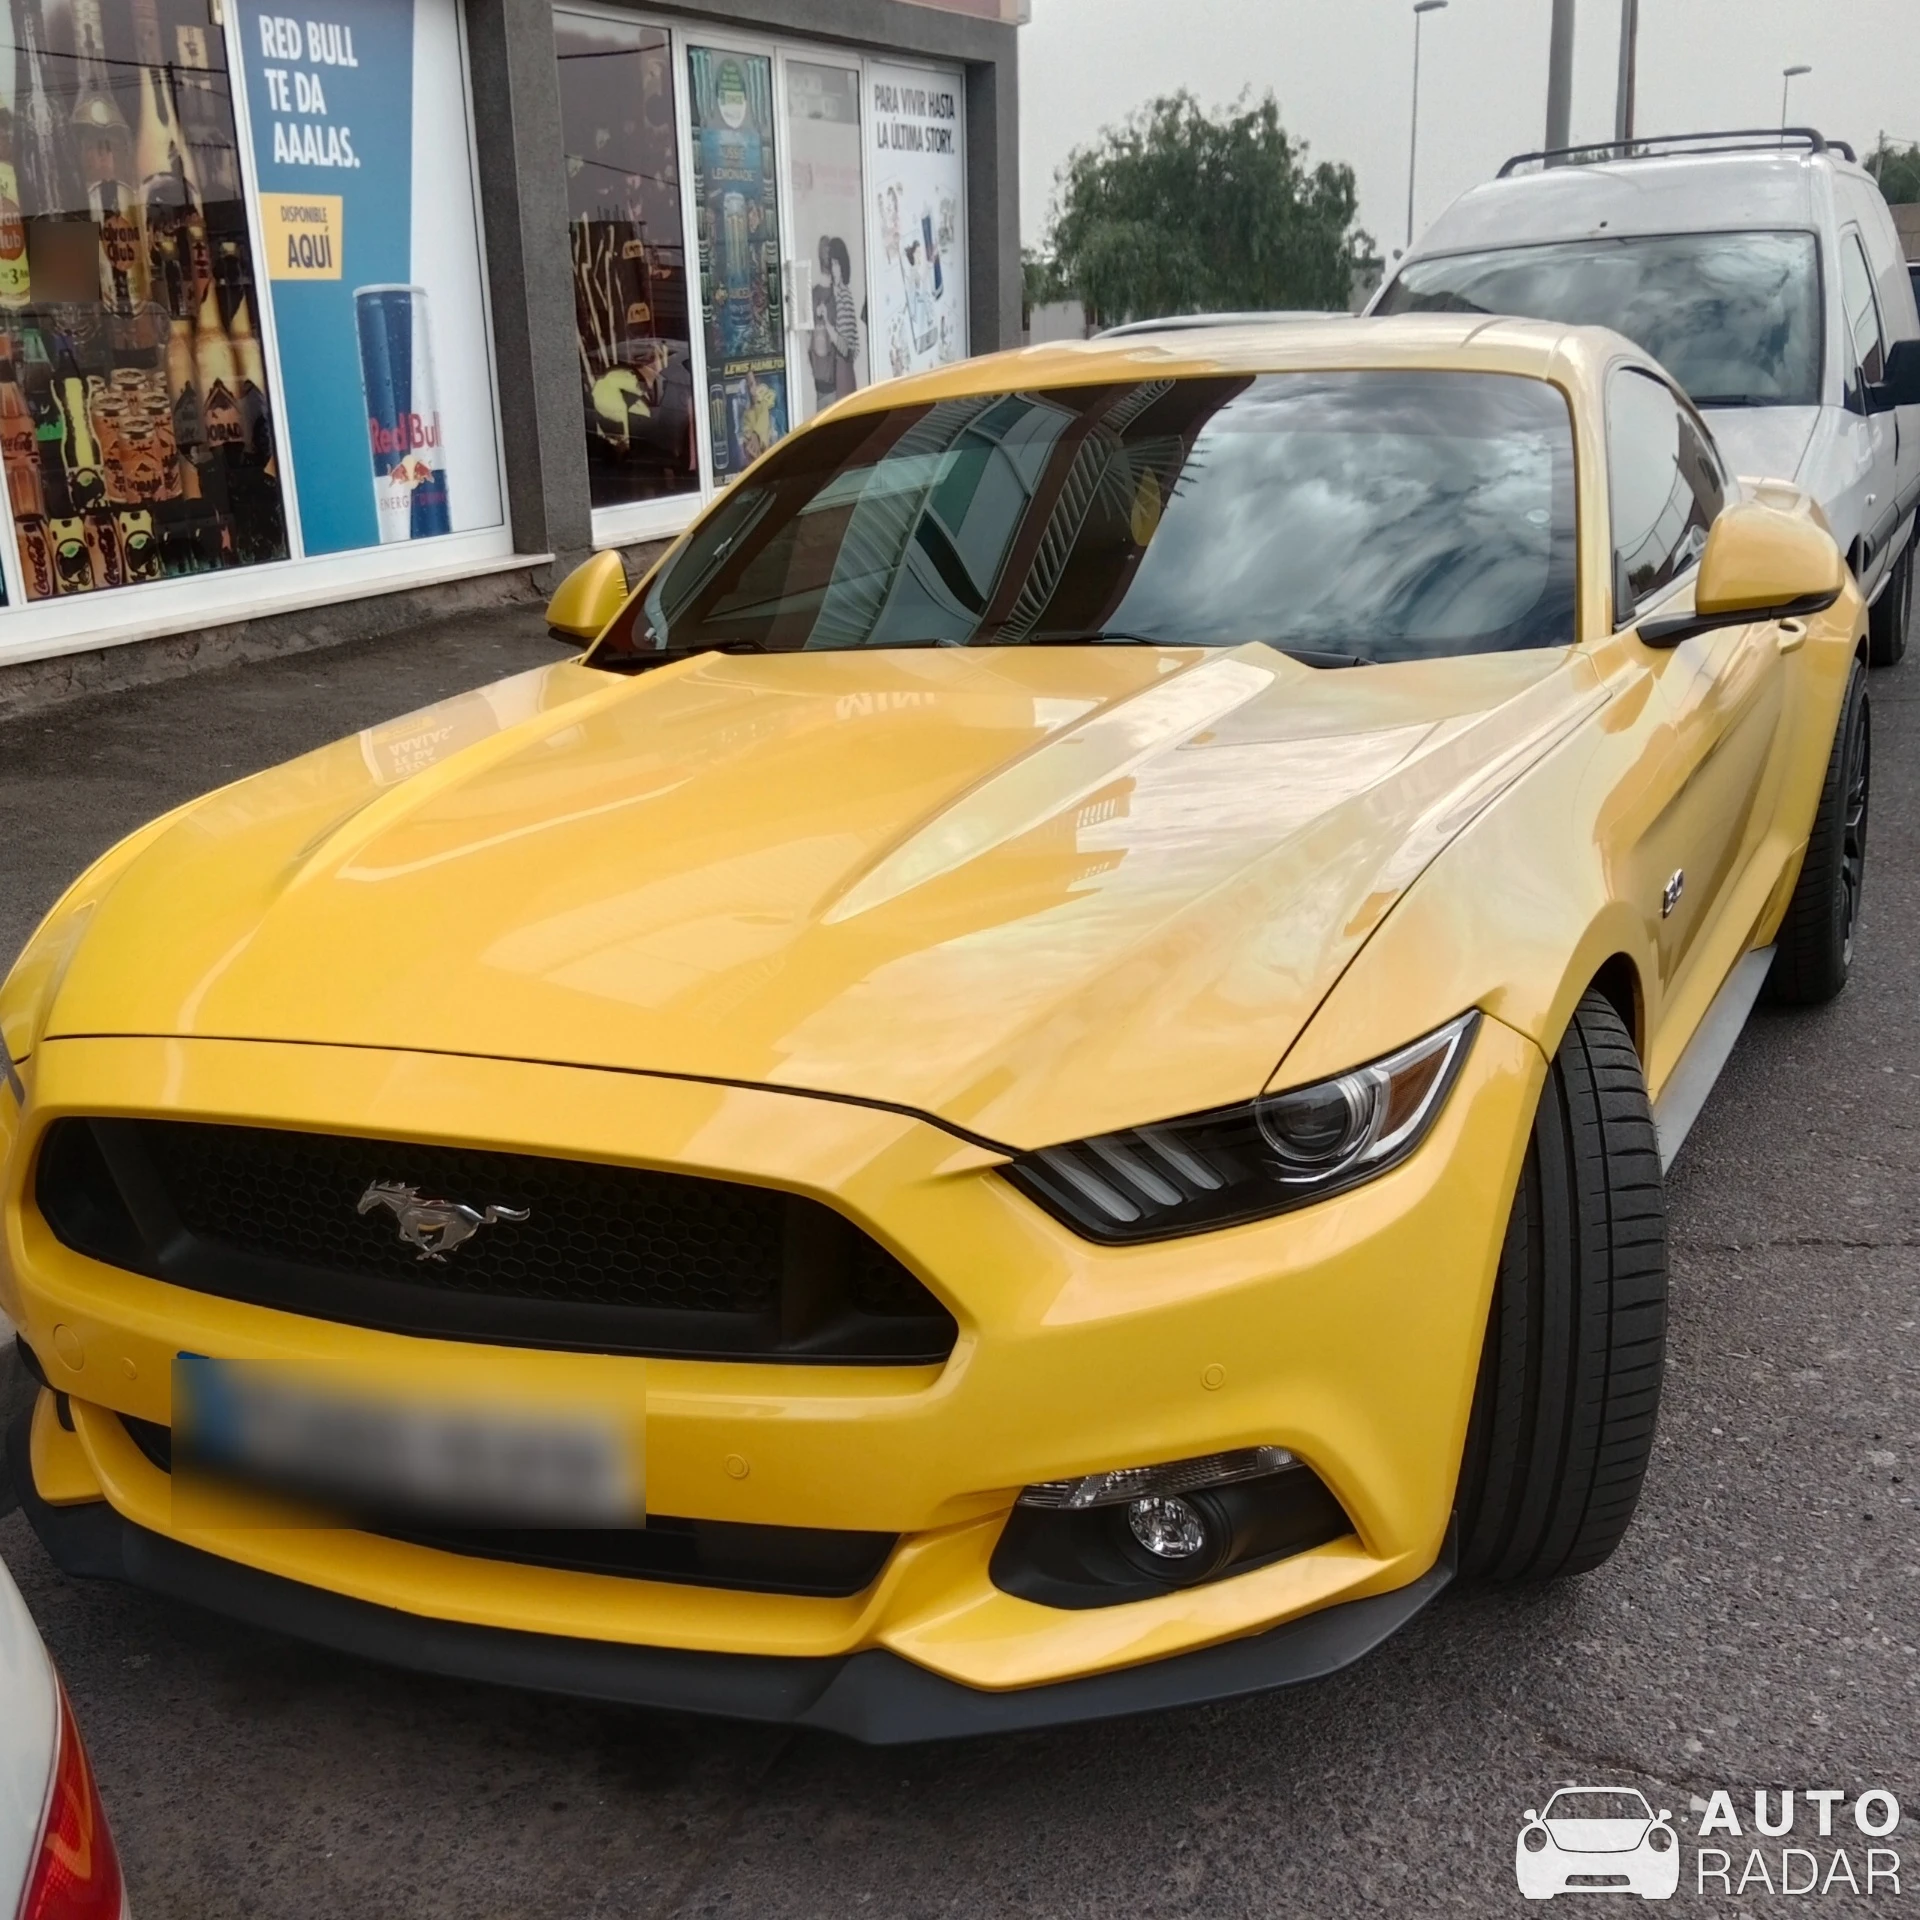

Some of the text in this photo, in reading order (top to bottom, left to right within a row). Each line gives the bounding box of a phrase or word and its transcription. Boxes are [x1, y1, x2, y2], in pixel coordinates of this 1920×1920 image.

[258, 14, 358, 67] RED BULL
[263, 68, 328, 115] TE DA
[874, 83, 900, 114] PARA
[900, 87, 927, 117] VIVIR
[928, 91, 955, 120] HASTA
[274, 121, 361, 168] AAALAS.
[877, 115, 955, 155] LA ÚLTIMA STORY.
[280, 205, 328, 223] DISPONIBLE
[287, 225, 332, 268] AQUÍ
[724, 362, 750, 377] LEWIS
[369, 412, 408, 454] Red
